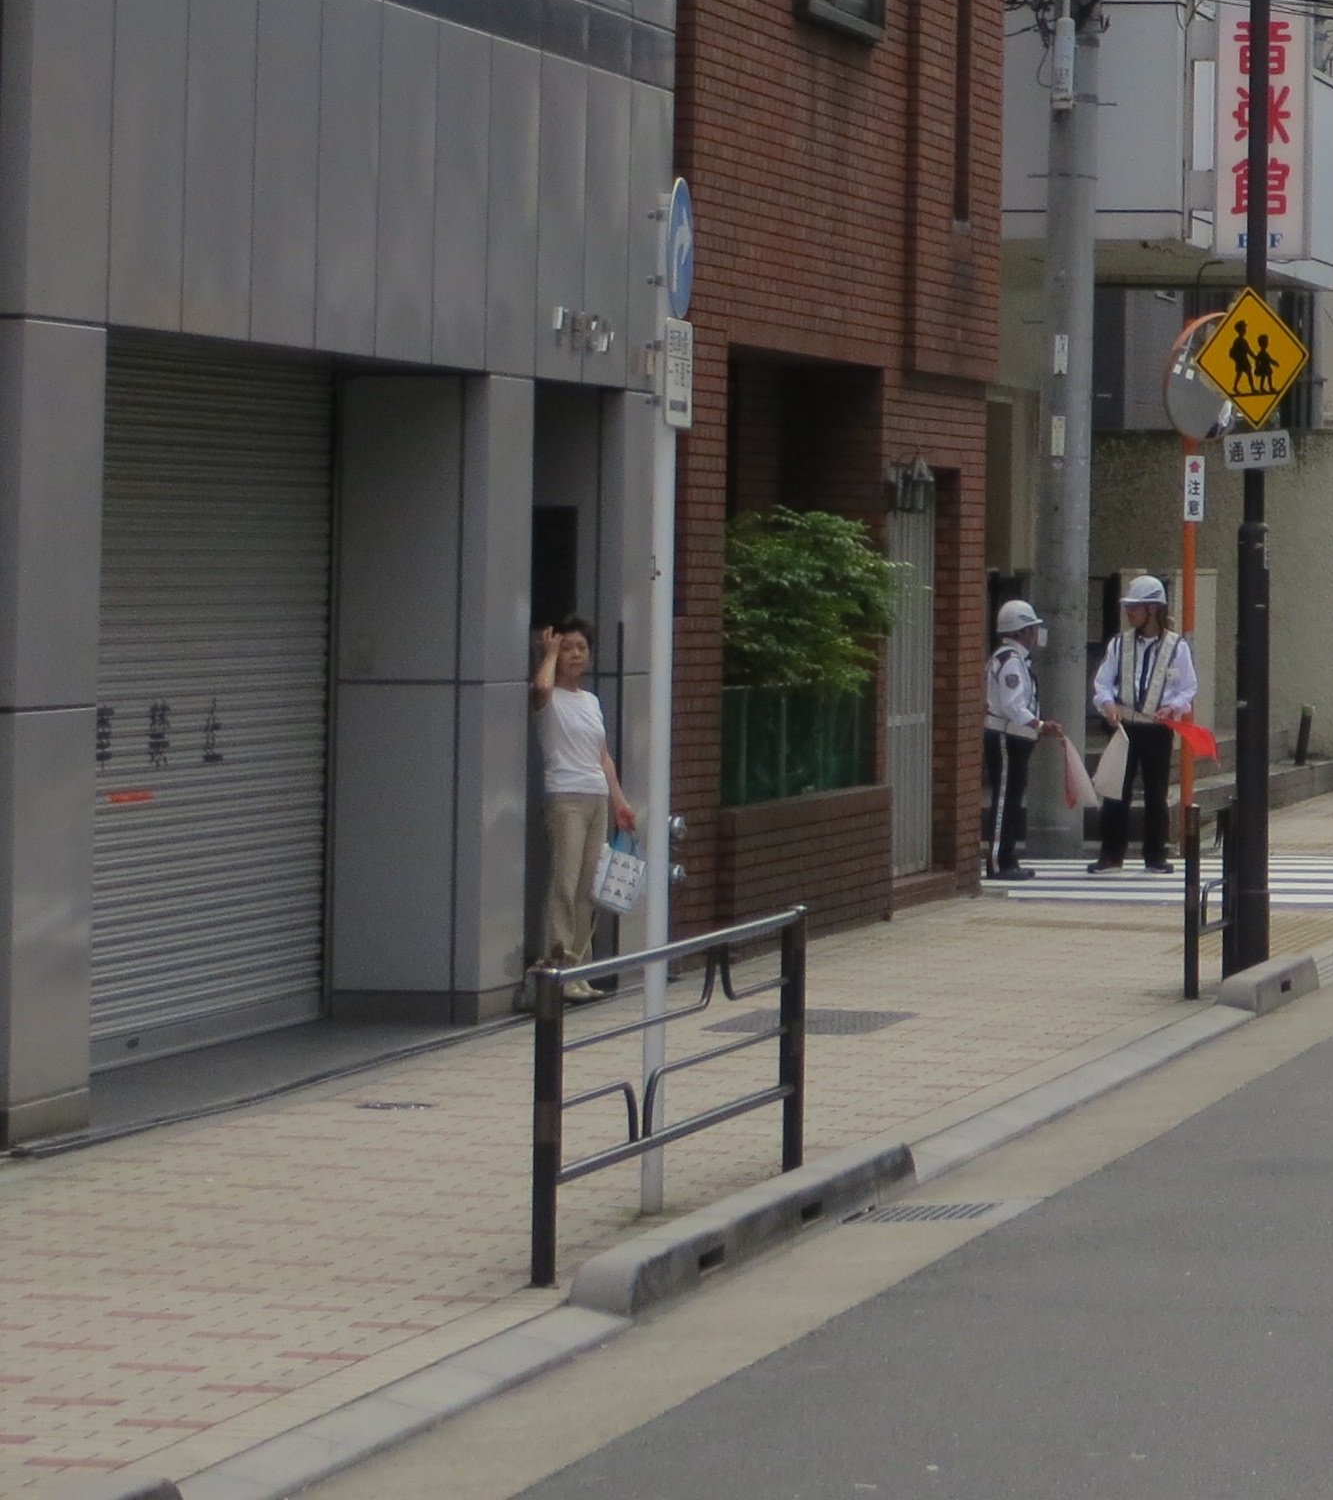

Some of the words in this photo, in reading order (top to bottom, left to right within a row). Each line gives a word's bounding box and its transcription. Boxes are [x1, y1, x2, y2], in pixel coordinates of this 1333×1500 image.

[1228, 438, 1289, 462] 通学路
[1187, 477, 1201, 517] 注意
